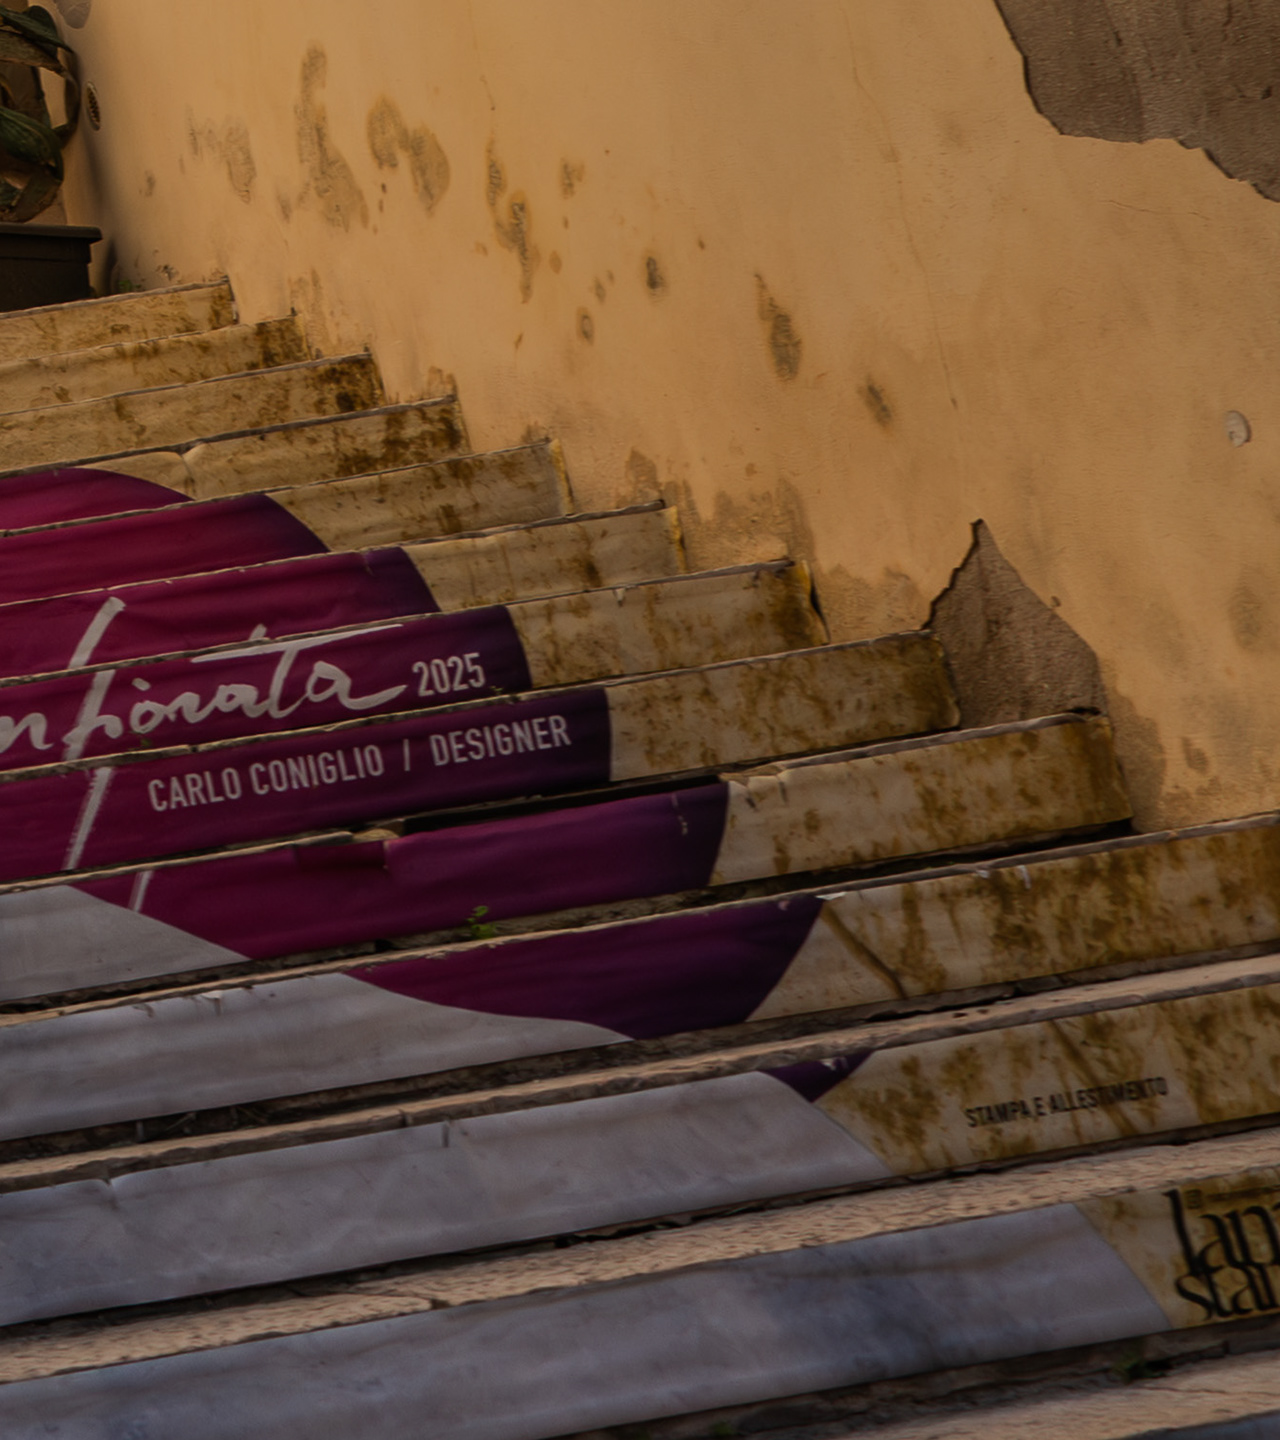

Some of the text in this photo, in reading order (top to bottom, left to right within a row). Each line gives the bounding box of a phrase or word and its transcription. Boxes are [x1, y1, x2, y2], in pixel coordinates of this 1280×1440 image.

[412, 652, 486, 697] 2025
[148, 768, 240, 812] CARLO
[248, 745, 384, 796] CONIGLIO
[429, 716, 572, 767] DESIGNER
[964, 1077, 1169, 1128] STAMPA E ALLESTIMENTO
